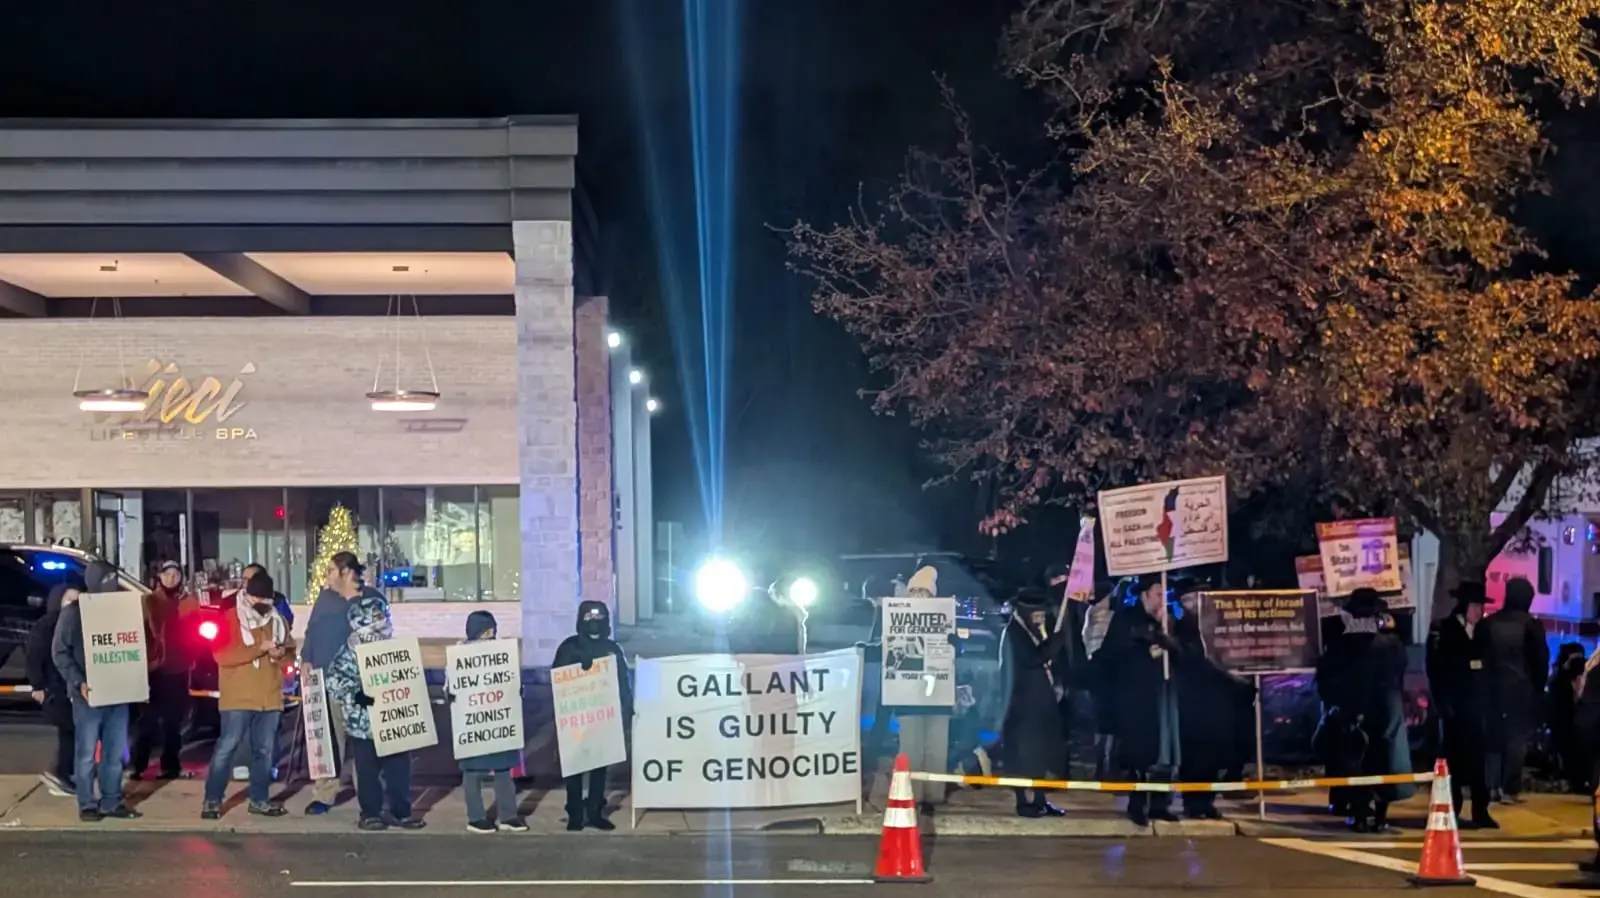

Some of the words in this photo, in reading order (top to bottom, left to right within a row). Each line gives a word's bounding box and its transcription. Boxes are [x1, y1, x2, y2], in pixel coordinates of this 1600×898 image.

[216, 427, 258, 440] SPA
[1214, 599, 1233, 609] The
[1235, 598, 1261, 608] State
[1263, 598, 1274, 608] of
[1275, 597, 1304, 608] Israel
[890, 612, 947, 626] WANTED
[1223, 610, 1242, 619] and
[1244, 609, 1257, 619] its
[1259, 608, 1295, 618] actions
[91, 632, 116, 647] FREE,
[116, 630, 138, 644] FREE
[890, 626, 905, 634] FOR
[907, 626, 947, 634] GENOCIDE
[93, 649, 141, 665] PALESTINE
[365, 649, 411, 669] ANOTHER
[455, 652, 509, 671] ANOTHER
[368, 672, 389, 687] JEW
[391, 666, 420, 683] SAYS:
[453, 673, 479, 690] JEW
[483, 670, 515, 686] SAYS:
[677, 668, 830, 698] GALLANT
[382, 686, 411, 704] STOP
[468, 690, 504, 706] STOP
[380, 703, 419, 723] ZIONIST
[465, 706, 511, 726] ZIONIST
[559, 706, 616, 732] PRISON
[379, 721, 427, 743] GENOCIDE
[458, 724, 516, 745] GENOCIDE
[666, 716, 696, 739] IS
[718, 711, 836, 739] GUILTY
[643, 758, 683, 782] OF
[702, 751, 858, 782] GENOCIDE
